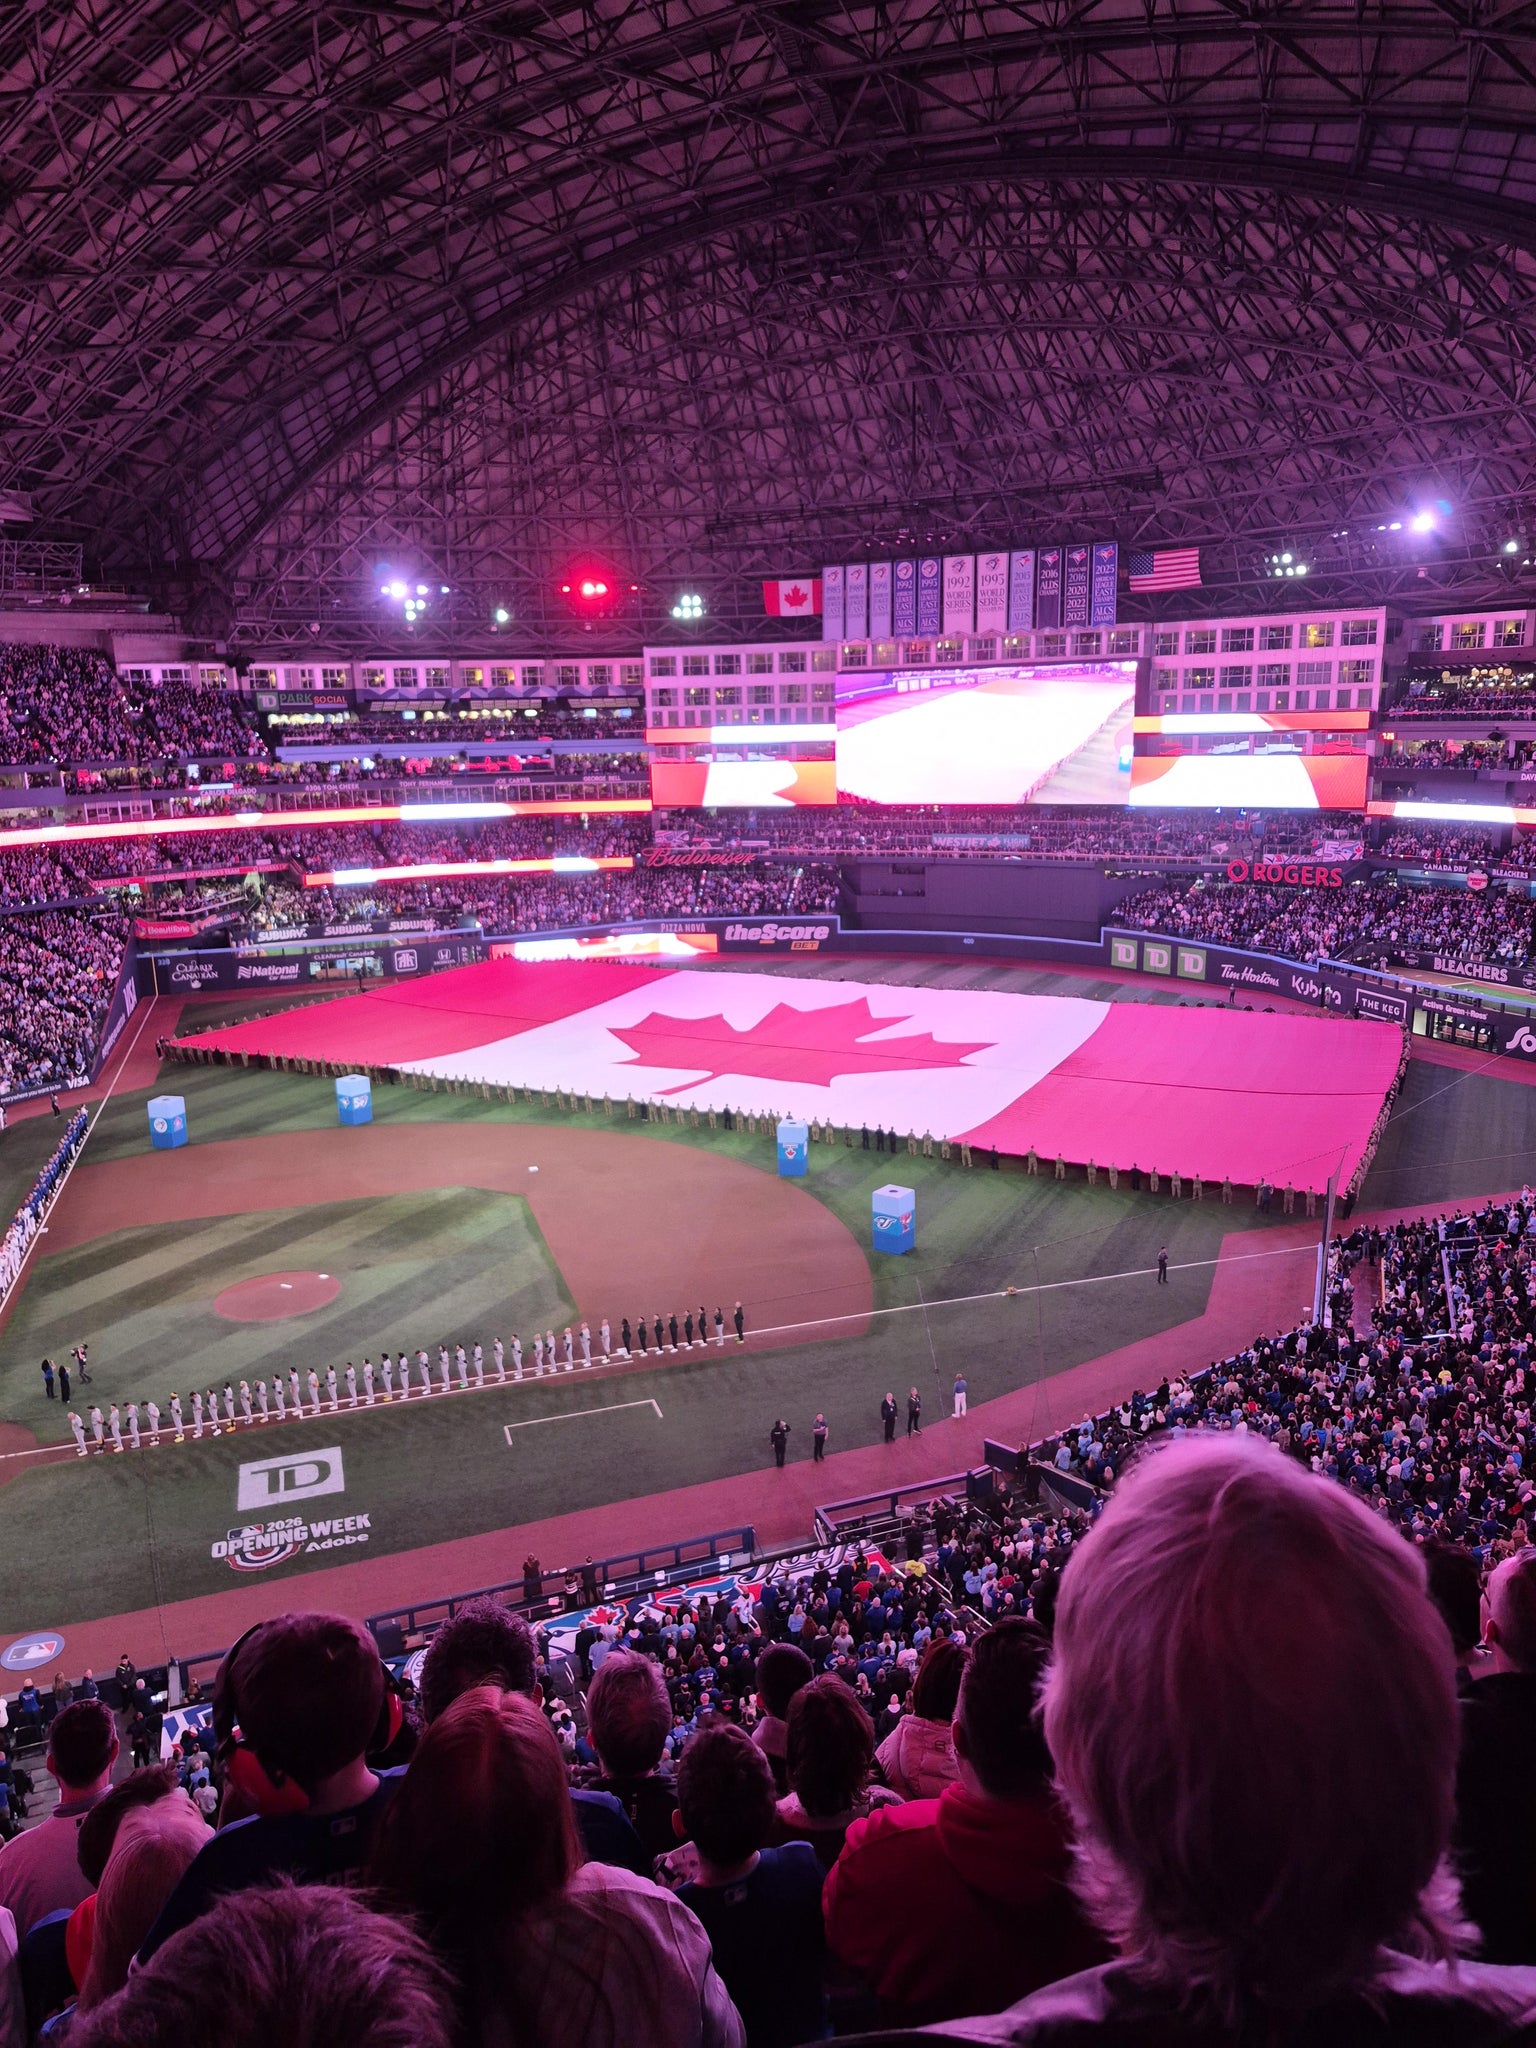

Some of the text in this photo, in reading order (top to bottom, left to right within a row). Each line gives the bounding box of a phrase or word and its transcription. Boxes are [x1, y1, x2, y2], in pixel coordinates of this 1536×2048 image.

[1040, 569, 1058, 579] 2016
[1096, 564, 1115, 575] 2025
[897, 580, 913, 590] 1992
[947, 576, 970, 589] 1992
[1040, 581, 1058, 590] ALDS
[946, 591, 971, 599] WORLD
[980, 588, 1005, 597] WORLD
[1067, 586, 1087, 595] 2020
[1095, 588, 1114, 596] EAST
[945, 600, 971, 608] SERIES
[979, 597, 1005, 606] SERIES
[1067, 599, 1086, 608] 2022
[1095, 606, 1114, 615] ALCS
[897, 619, 913, 628] ALCS
[921, 618, 938, 627] ALCS
[259, 693, 347, 708] TD PARK SOCIAL
[200, 789, 225, 797] CARLOS
[933, 836, 987, 847] WESTJET
[641, 846, 756, 867] Budweiser
[1423, 863, 1468, 873] CANADA DRY
[1492, 868, 1528, 879] BLEACHERS
[1253, 862, 1343, 887] ROGERS
[324, 923, 371, 936] SUBWAY
[660, 922, 706, 933] PIZZA NOVA
[725, 923, 829, 941] theScore
[258, 928, 305, 942] SUBWAY
[793, 941, 818, 949] BET
[1114, 942, 1136, 963] TD
[1147, 947, 1169, 968] TD
[1180, 952, 1204, 974] TD
[252, 963, 299, 977] National
[1220, 963, 1280, 987] Tim Hortons
[1433, 957, 1509, 982] BLEACHERS
[171, 971, 219, 981] CANADIAN
[279, 973, 298, 981] Rental
[1362, 997, 1400, 1016] THE KEG
[1422, 999, 1444, 1011] Active
[66, 1075, 90, 1089] VISA
[28, 1089, 37, 1098] you
[38, 1086, 50, 1094] want
[251, 1460, 331, 1495] TD
[266, 1516, 303, 1532] 2026
[211, 1513, 372, 1559] OPENING WEEK
[304, 1533, 370, 1553] Adobe
